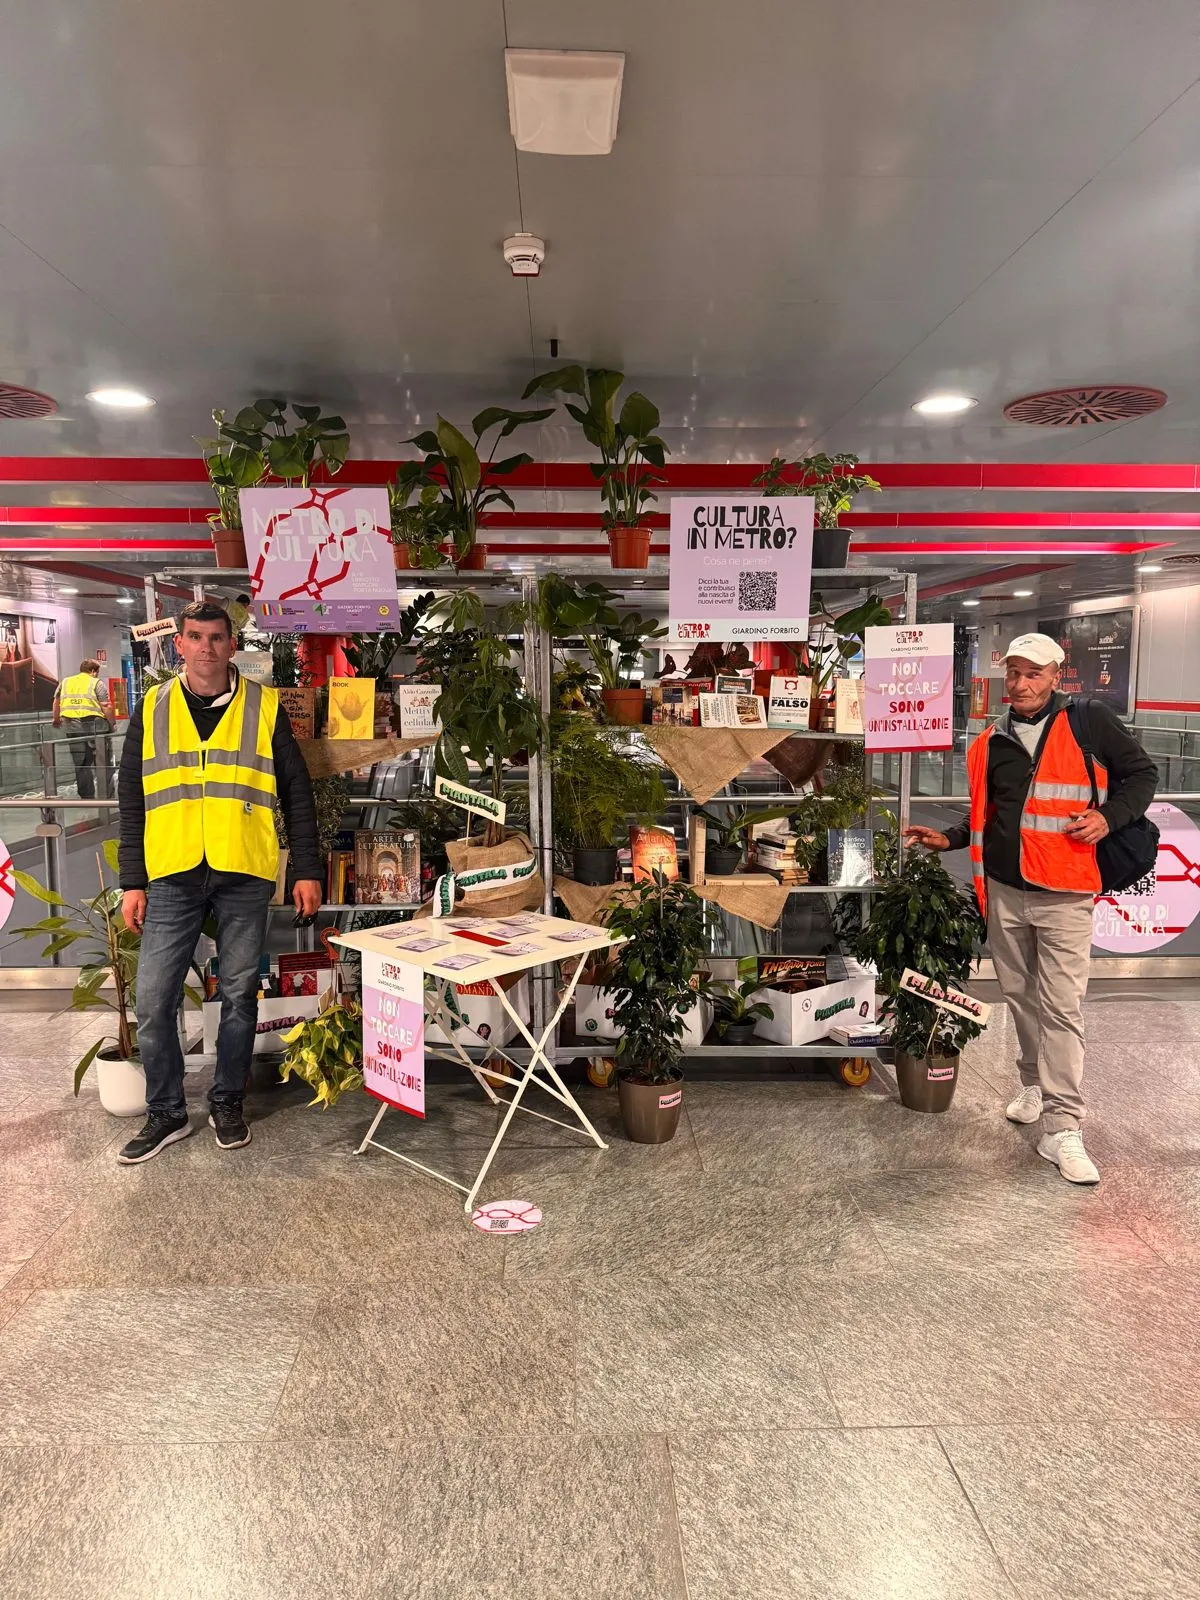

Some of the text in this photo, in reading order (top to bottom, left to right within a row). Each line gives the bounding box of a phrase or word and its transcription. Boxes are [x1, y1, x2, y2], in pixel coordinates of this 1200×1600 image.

[252, 507, 378, 536] METRO DI
[693, 505, 785, 528] CULTURA
[687, 527, 797, 550] IN METRO?
[259, 535, 379, 562] CULTURA
[703, 555, 773, 568] Cosa ne pensi?
[698, 577, 713, 585] Dicci
[677, 623, 702, 631] METRO
[677, 630, 710, 639] CULTURA
[732, 627, 800, 635] GIARDINO FORBITO
[892, 661, 923, 676] NON
[879, 681, 940, 697] TOCCARE
[771, 699, 809, 709] FALSO
[889, 700, 925, 714] SONO
[868, 717, 949, 733] UN'INSTALLAZIONE
[439, 782, 500, 817] PIANTALA
[358, 842, 418, 850] LETTERATURA
[372, 835, 394, 843] ARTE
[1093, 904, 1169, 921] METRO DI
[1095, 920, 1167, 937] CULTURA
[759, 959, 804, 979] INDIANA
[378, 996, 400, 1020] NON
[370, 1016, 413, 1046] TOCCARE
[377, 1040, 402, 1063] SONO
[364, 1052, 422, 1093] UN'INSTALLAZIONE
